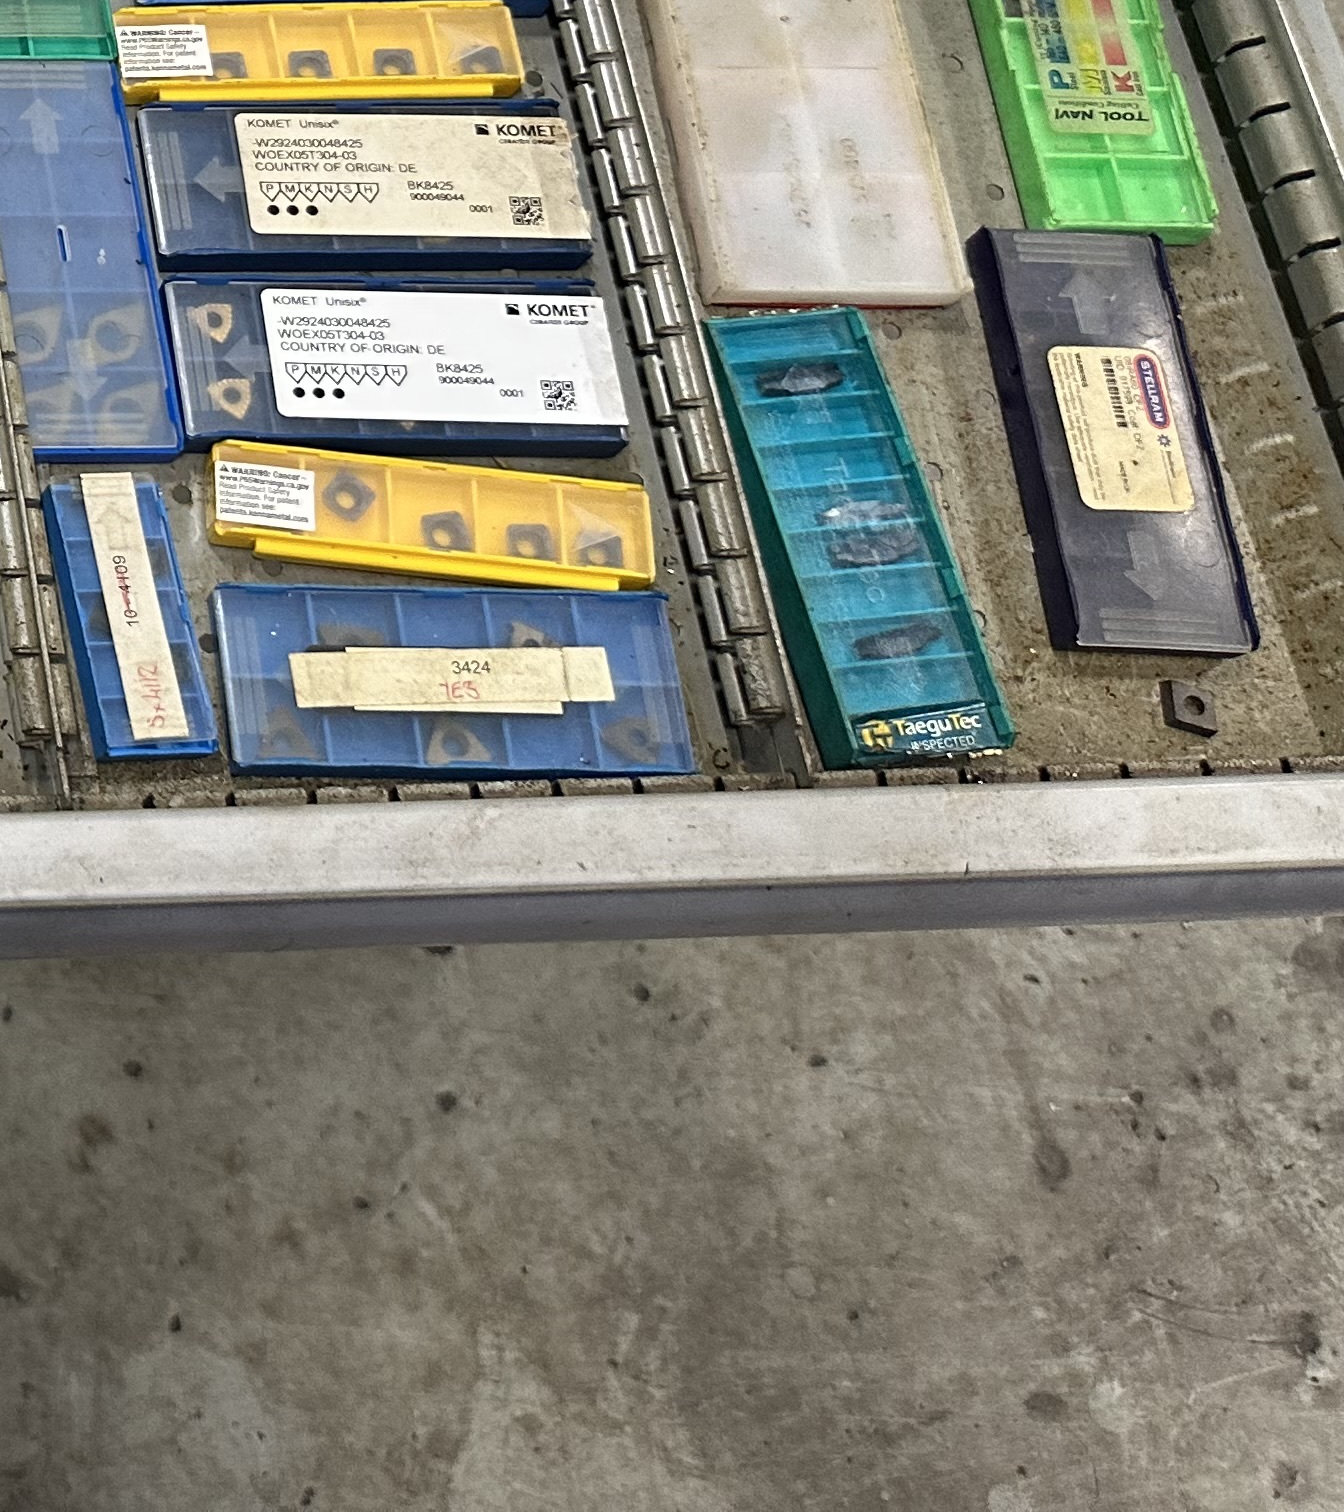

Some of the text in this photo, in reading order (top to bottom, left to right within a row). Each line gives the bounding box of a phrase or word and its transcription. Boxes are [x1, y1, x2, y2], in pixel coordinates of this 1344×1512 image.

[1047, 67, 1069, 92] P
[1110, 68, 1134, 93] K
[1097, 111, 1149, 121] TOOL
[246, 119, 291, 128] KOMET
[495, 124, 554, 137] KOMET
[254, 162, 318, 171] COUNTRY
[322, 162, 340, 171] OF
[398, 163, 417, 172] DE
[406, 180, 453, 190] BK8425
[272, 295, 316, 306] KOMET
[525, 304, 588, 317] KOMET
[280, 340, 345, 352] COUNTRY
[350, 342, 368, 353] OF
[426, 344, 445, 354] DE
[435, 363, 483, 374] BK8425
[499, 389, 524, 398] 0001
[1139, 359, 1164, 423] STELLRAM
[450, 659, 490, 674] 3424
[892, 710, 983, 741] TaeguTec
